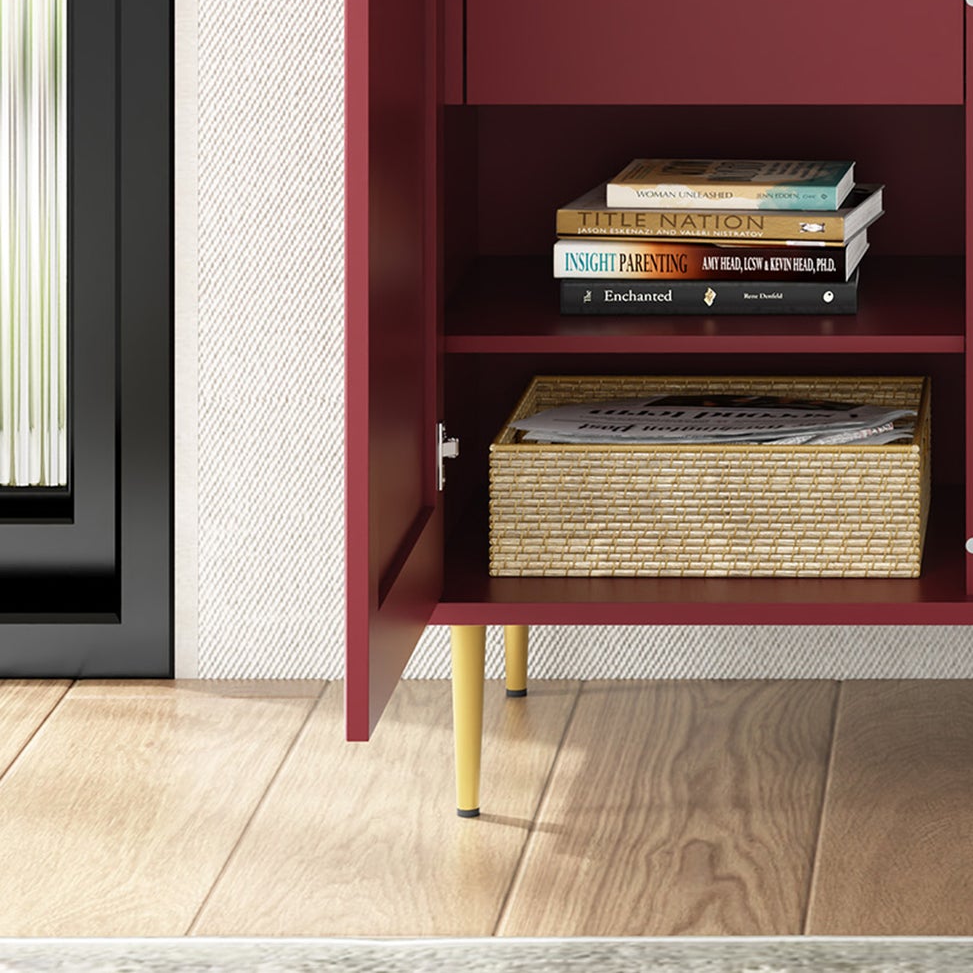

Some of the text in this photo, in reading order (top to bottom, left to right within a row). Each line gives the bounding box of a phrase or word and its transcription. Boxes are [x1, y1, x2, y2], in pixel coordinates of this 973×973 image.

[636, 190, 734, 199] WOMAN UNLEASHED
[577, 211, 764, 230] TITLE NATION
[577, 227, 607, 235] JASON
[565, 252, 688, 274] INSIGHT PARENTING
[702, 256, 719, 270] AMY
[720, 256, 744, 274] HEAD,
[744, 257, 763, 271] LCSW
[764, 260, 769, 271] &
[770, 257, 792, 272] KEVIN
[793, 257, 816, 274] HEAD,
[604, 289, 673, 302] Enchanted
